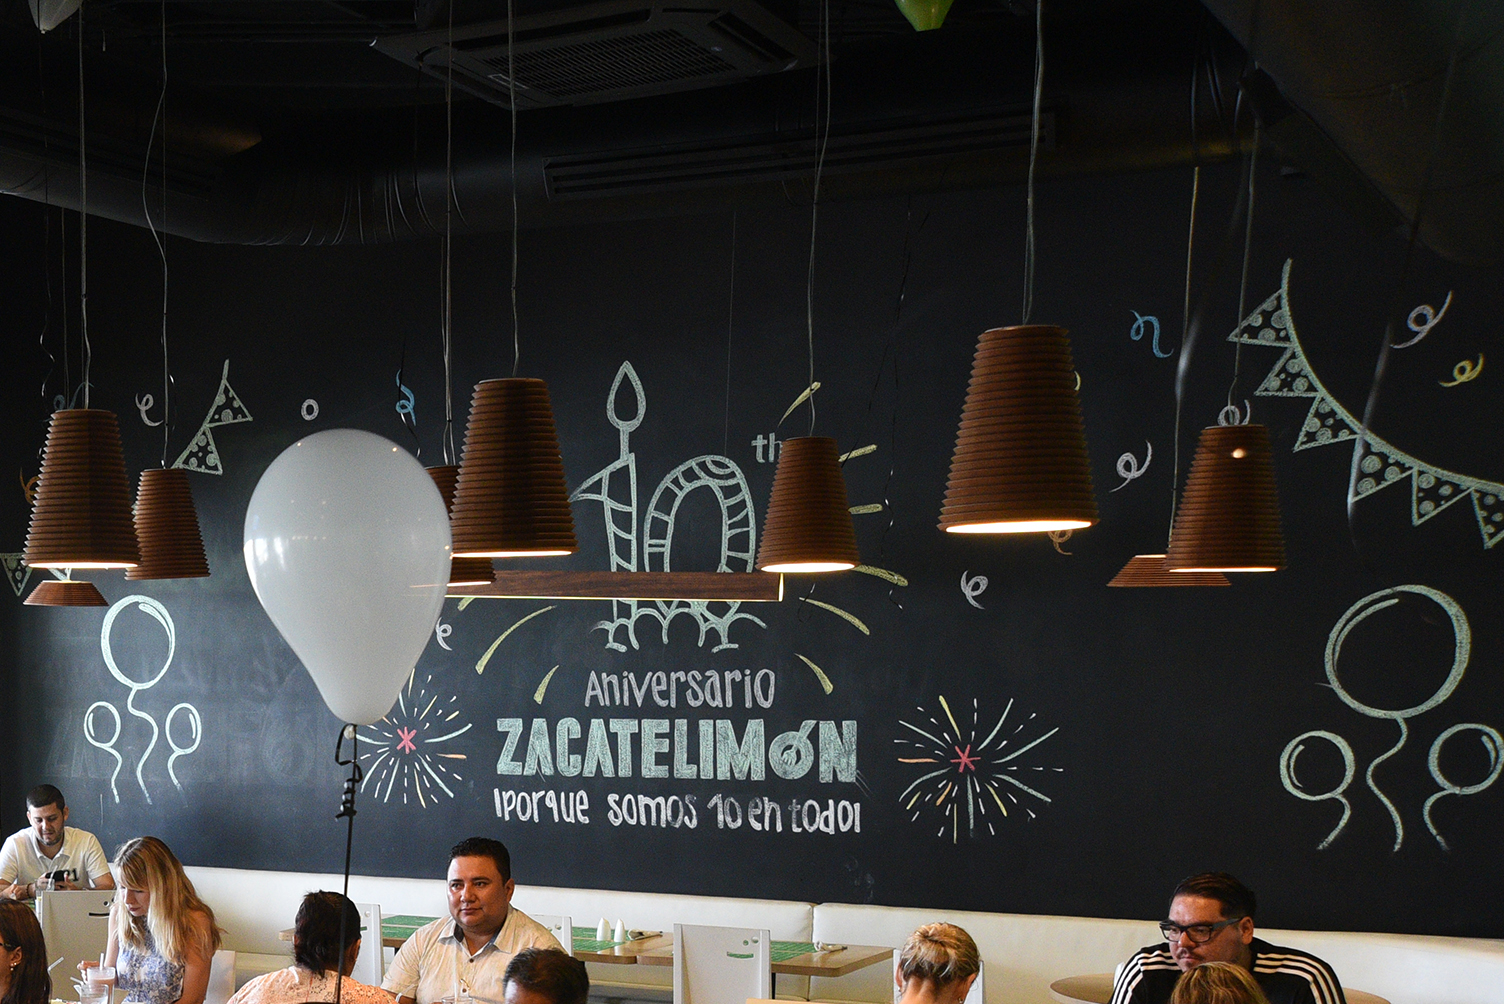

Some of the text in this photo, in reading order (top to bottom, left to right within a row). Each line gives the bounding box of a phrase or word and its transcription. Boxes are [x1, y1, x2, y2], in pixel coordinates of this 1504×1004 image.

[584, 668, 777, 709] Aniversario
[607, 793, 698, 830] somos
[706, 793, 743, 830] 10
[747, 797, 783, 833] en
